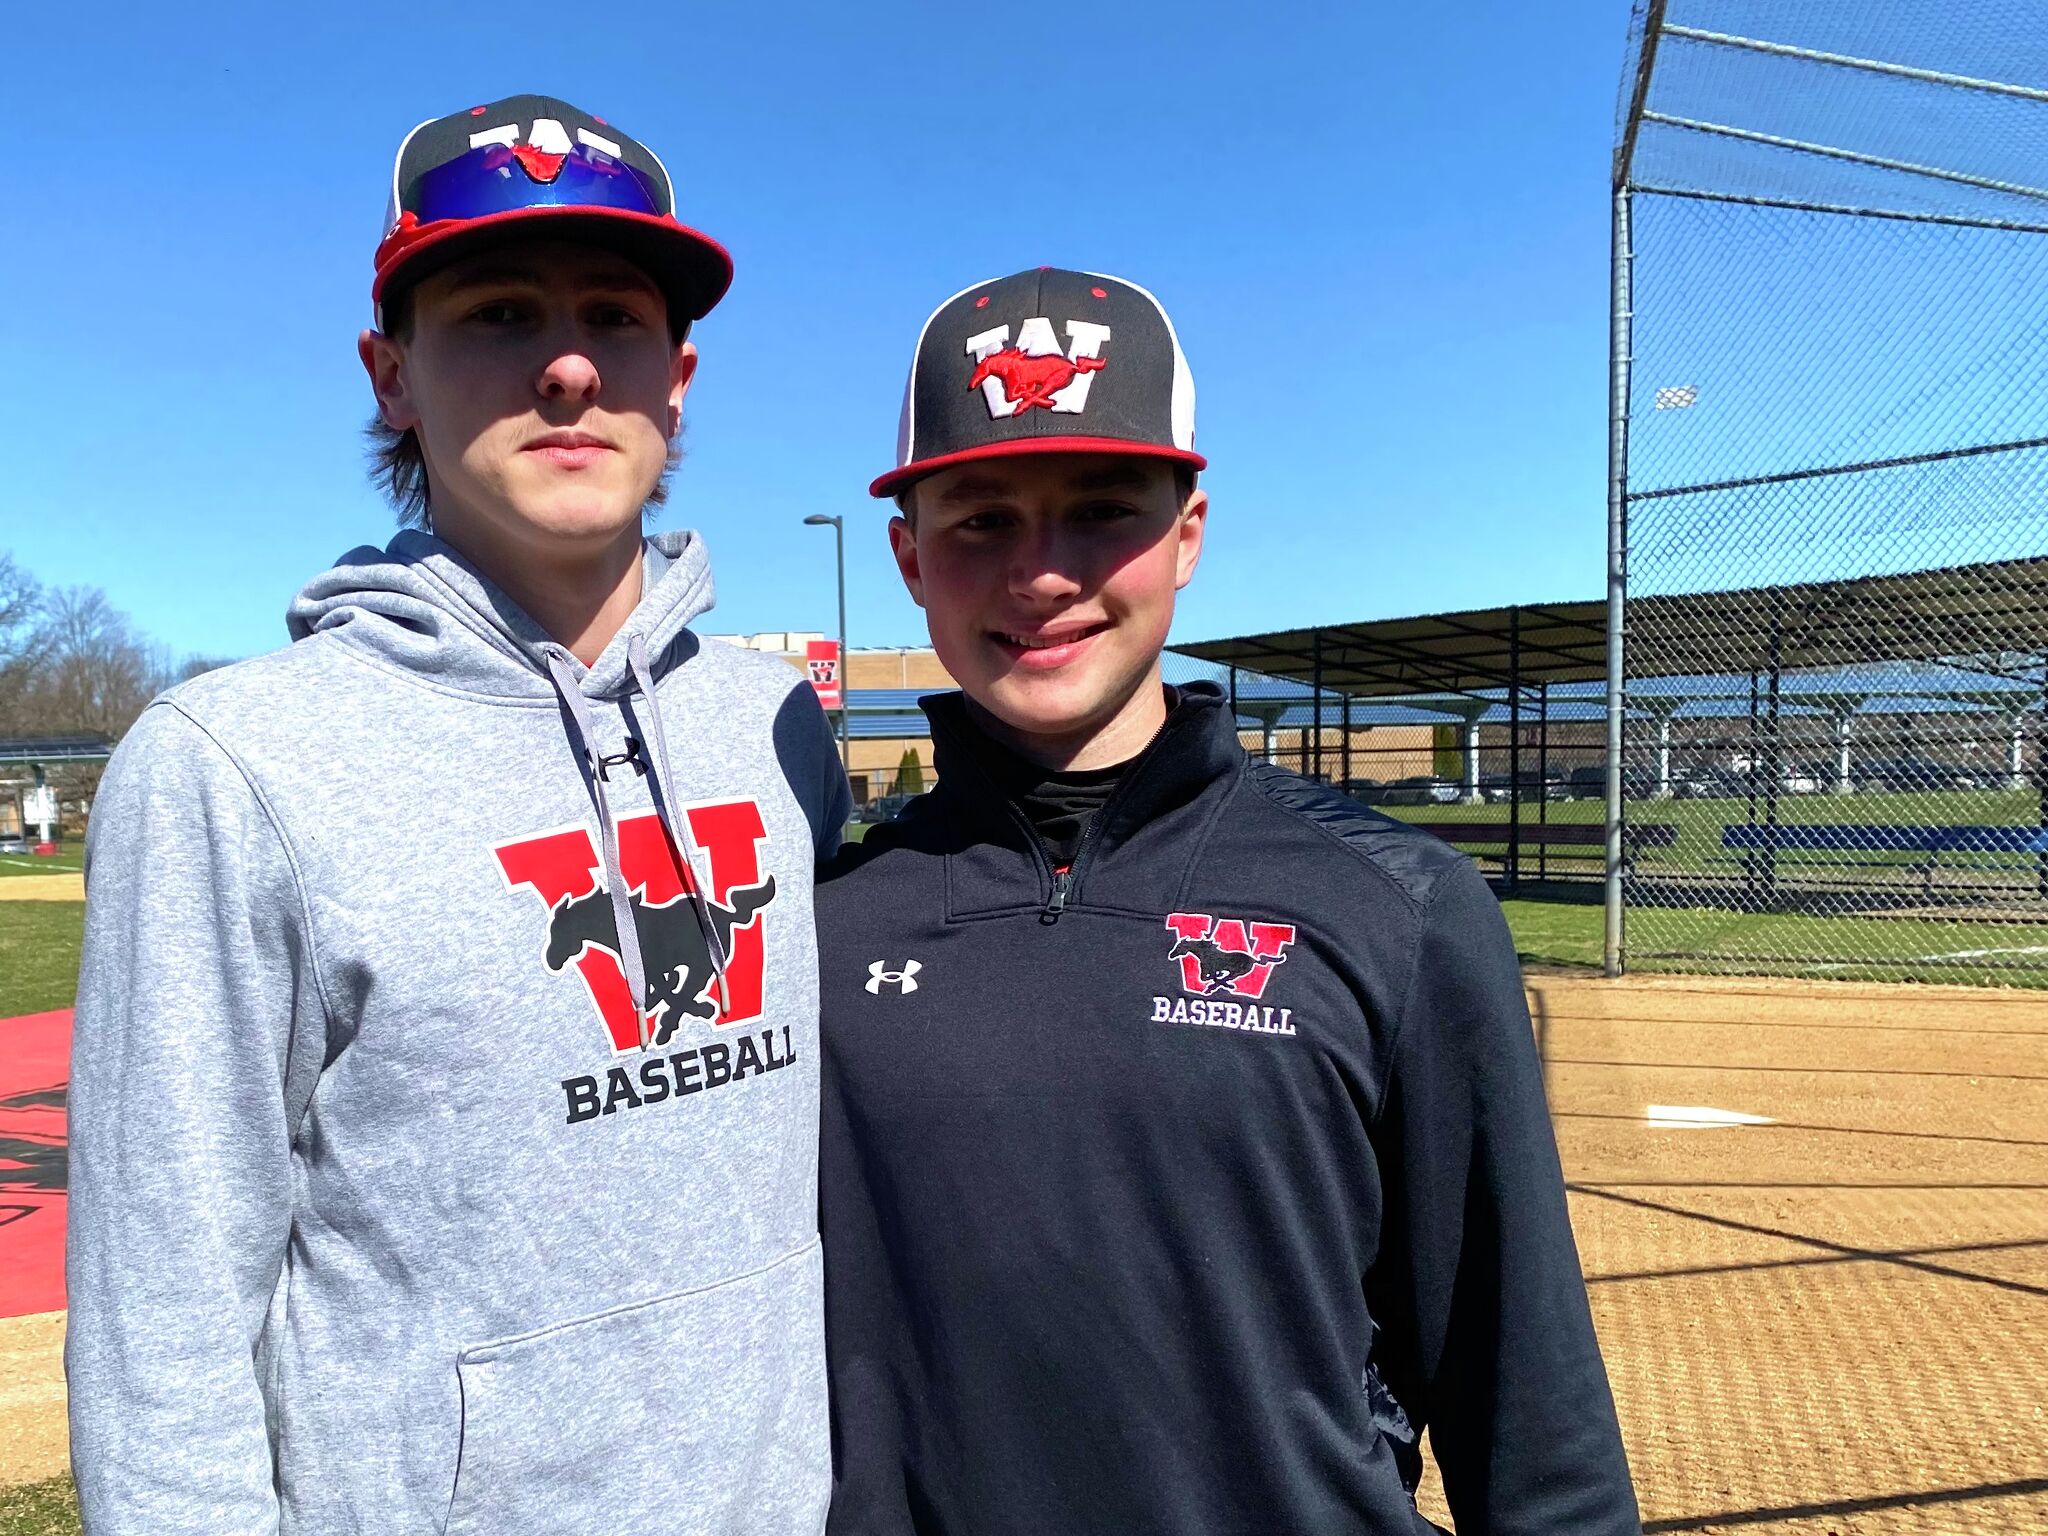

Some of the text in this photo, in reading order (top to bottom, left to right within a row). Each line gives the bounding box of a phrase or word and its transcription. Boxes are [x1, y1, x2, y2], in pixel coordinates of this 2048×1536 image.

[1166, 913, 1296, 999] W
[1150, 996, 1297, 1036] BASEBALL
[561, 1025, 797, 1124] BASEBALL
